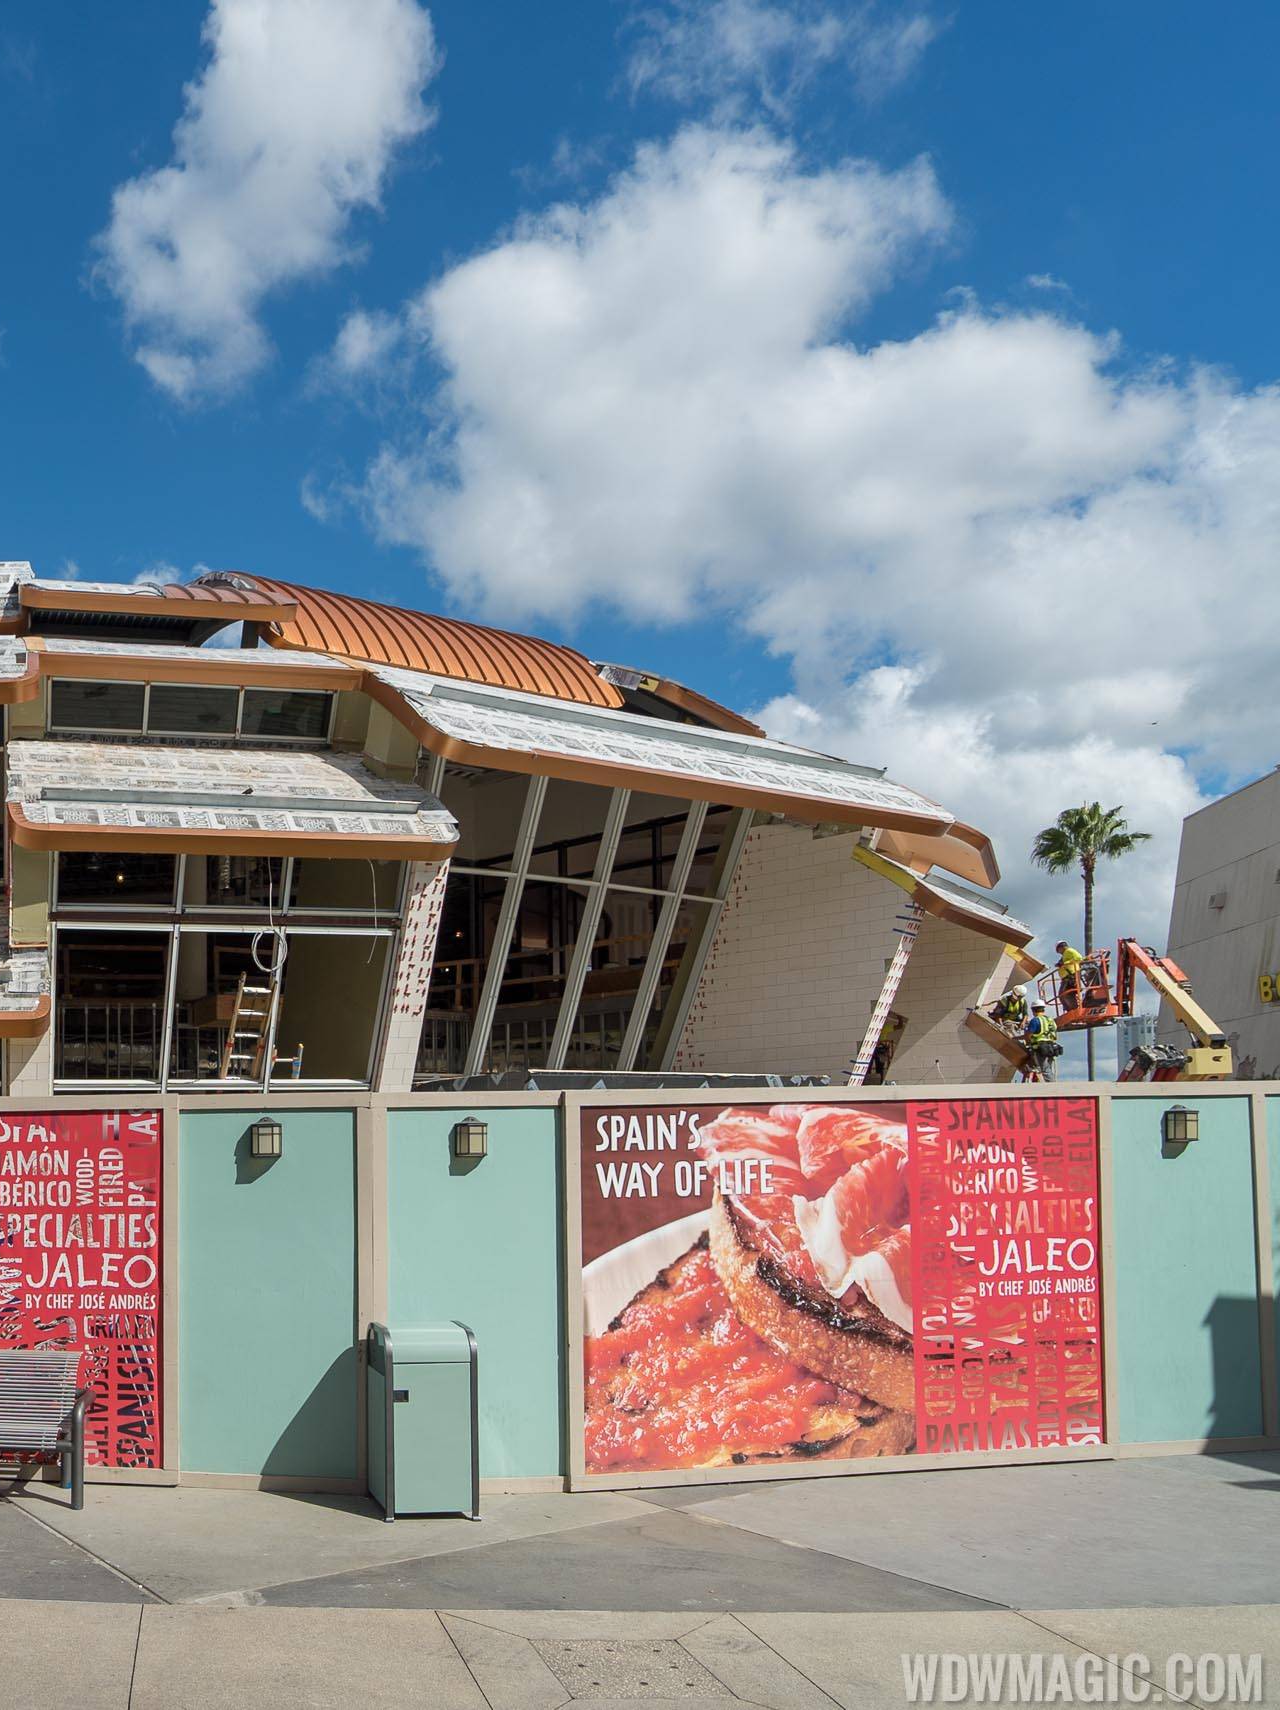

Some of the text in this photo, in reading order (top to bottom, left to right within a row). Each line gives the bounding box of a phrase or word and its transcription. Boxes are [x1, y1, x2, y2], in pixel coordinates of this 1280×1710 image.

[595, 1110, 701, 1152] SPAIN'S
[947, 1099, 1060, 1131] SPANISH
[75, 1148, 124, 1207] WOOD- FIRED
[595, 1159, 774, 1199] WAY OF LIFE
[26, 1252, 157, 1290] JALEO
[978, 1237, 1095, 1276] JALEO
[26, 1291, 157, 1310] BY CHEF JOSÉ ANDRÉS
[979, 1276, 1096, 1297] BY CHEF JOSÉ ANDRÉS
[925, 1417, 1032, 1451] PAELLAS
